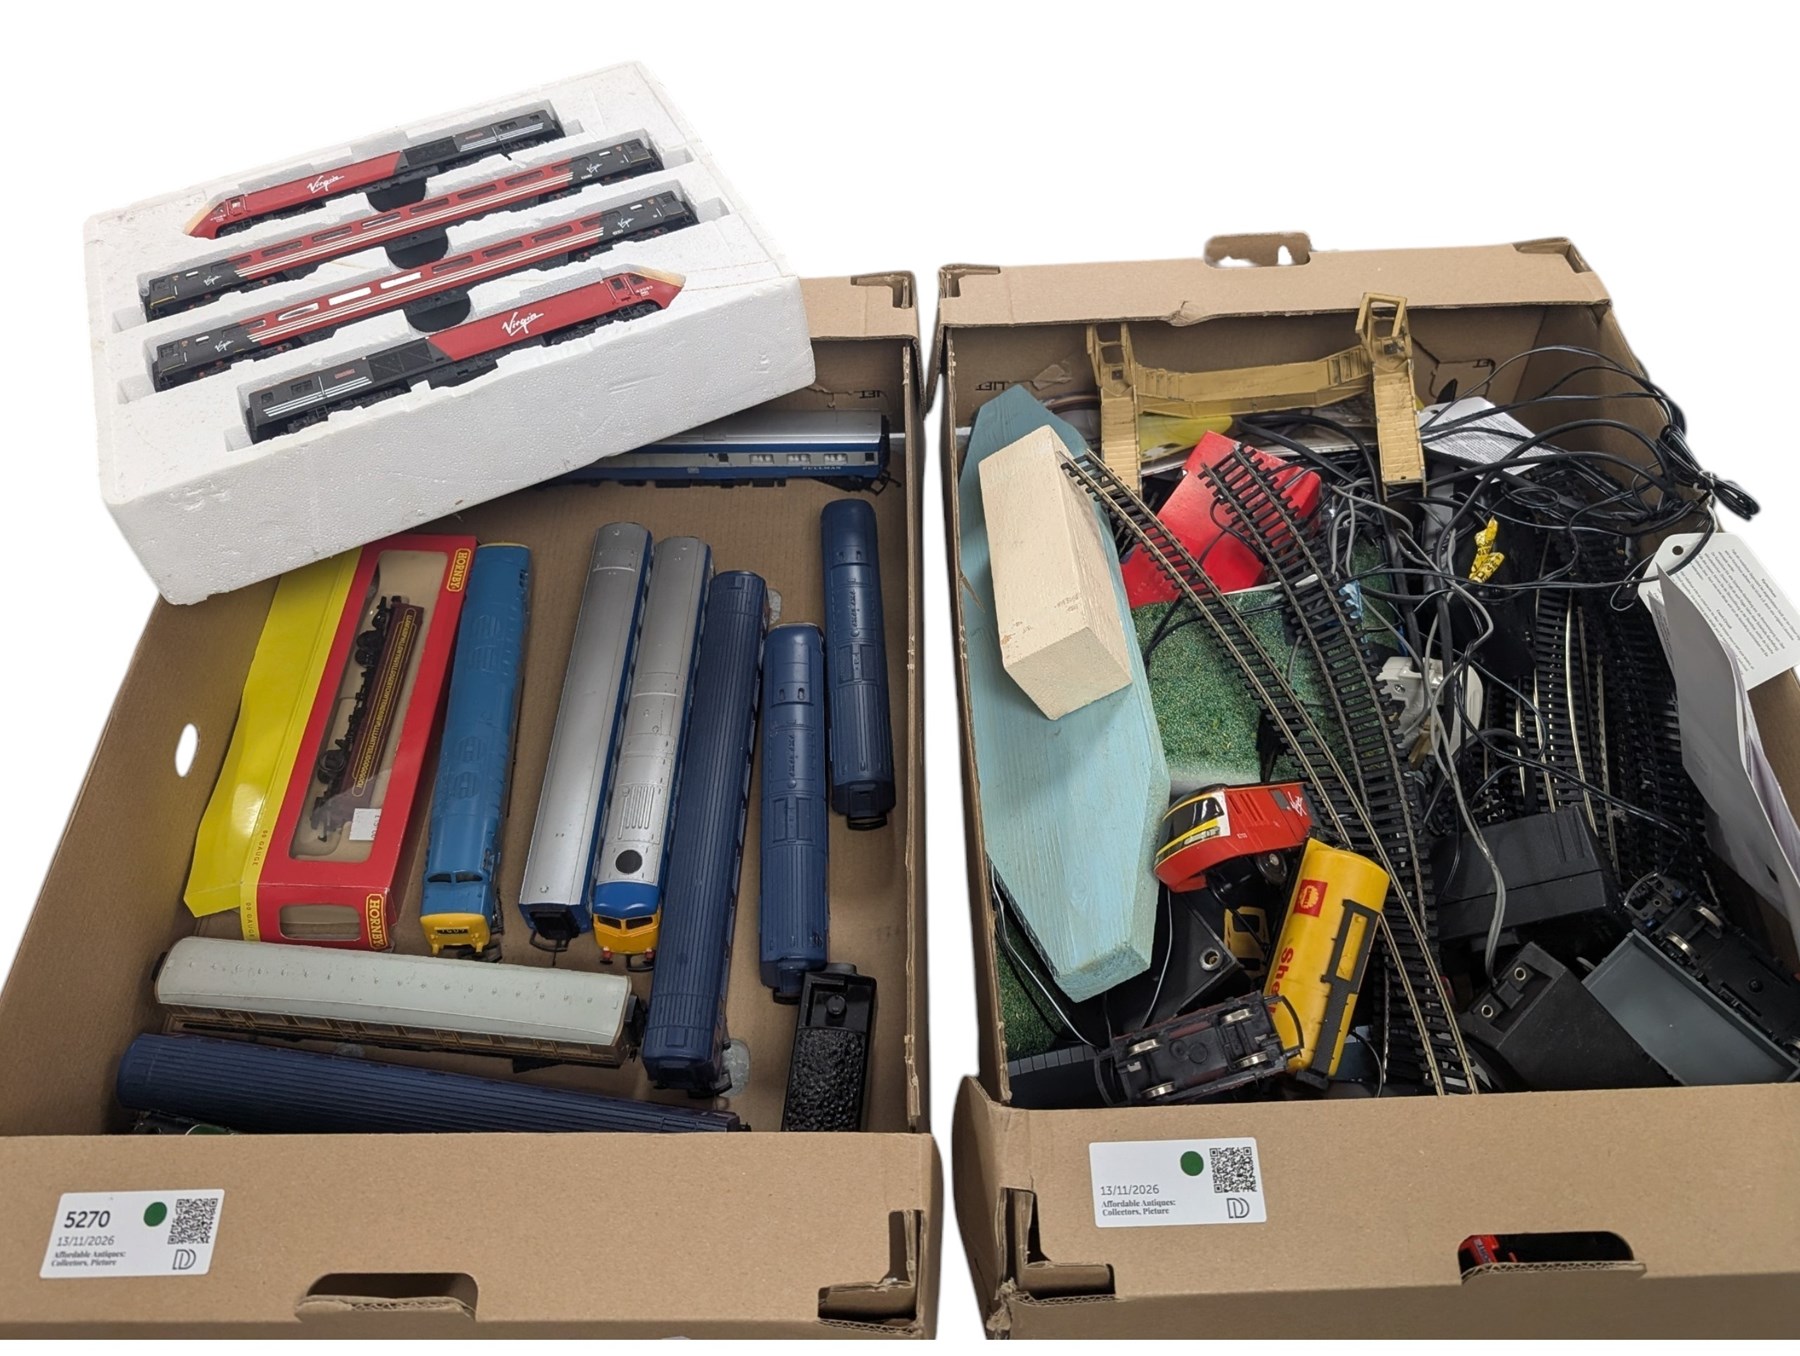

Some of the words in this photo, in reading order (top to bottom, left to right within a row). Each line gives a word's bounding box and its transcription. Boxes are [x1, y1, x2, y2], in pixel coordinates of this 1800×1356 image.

[307, 175, 345, 194] Virgin
[502, 312, 544, 336] Virgin
[450, 552, 468, 588] HORNBY
[252, 840, 265, 866] GAUGE
[369, 899, 385, 947] HORNBY
[1100, 1184, 1160, 1196] 13/11/2026
[1101, 1200, 1140, 1208] Affordable
[1141, 1199, 1176, 1208] Antiques:
[63, 1210, 111, 1229] 5270
[1102, 1208, 1142, 1216] Collectors,
[57, 1235, 115, 1247] 13/11/2026
[93, 1250, 126, 1259] Antiques:
[51, 1259, 89, 1267] Collectors,
